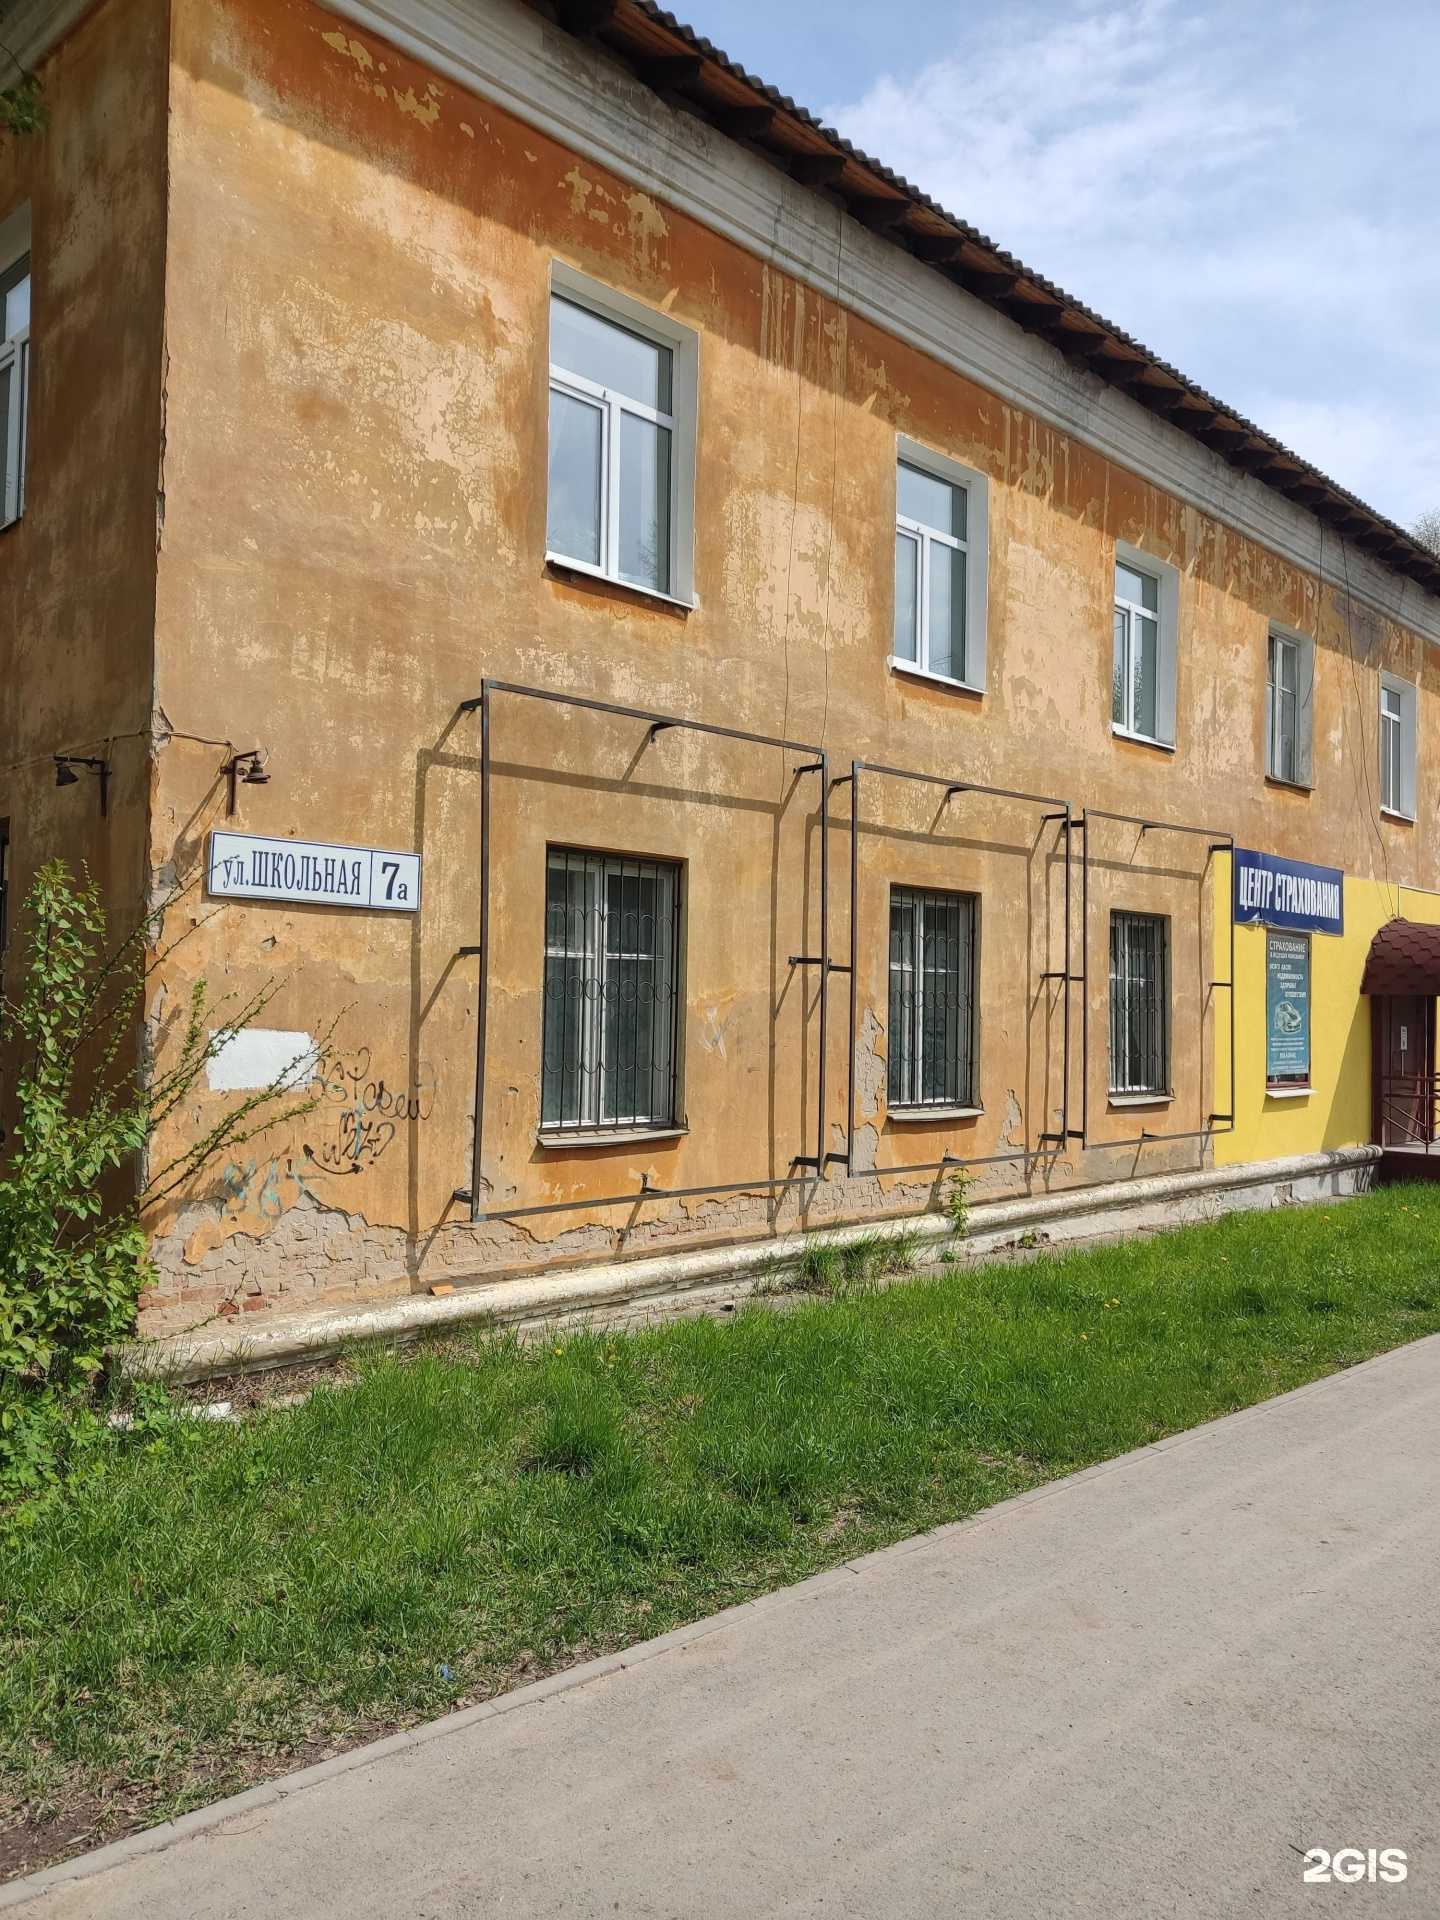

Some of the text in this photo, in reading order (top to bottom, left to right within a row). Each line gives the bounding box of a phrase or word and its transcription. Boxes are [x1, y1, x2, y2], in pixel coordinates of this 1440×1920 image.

[223, 850, 408, 901] ул.ШКОЛЬНАЯ 7а
[1239, 866, 1340, 920] ЦЕНТР СТРАХОВАНИЯ
[1269, 940, 1306, 953] СТРАХОВАНИЕ
